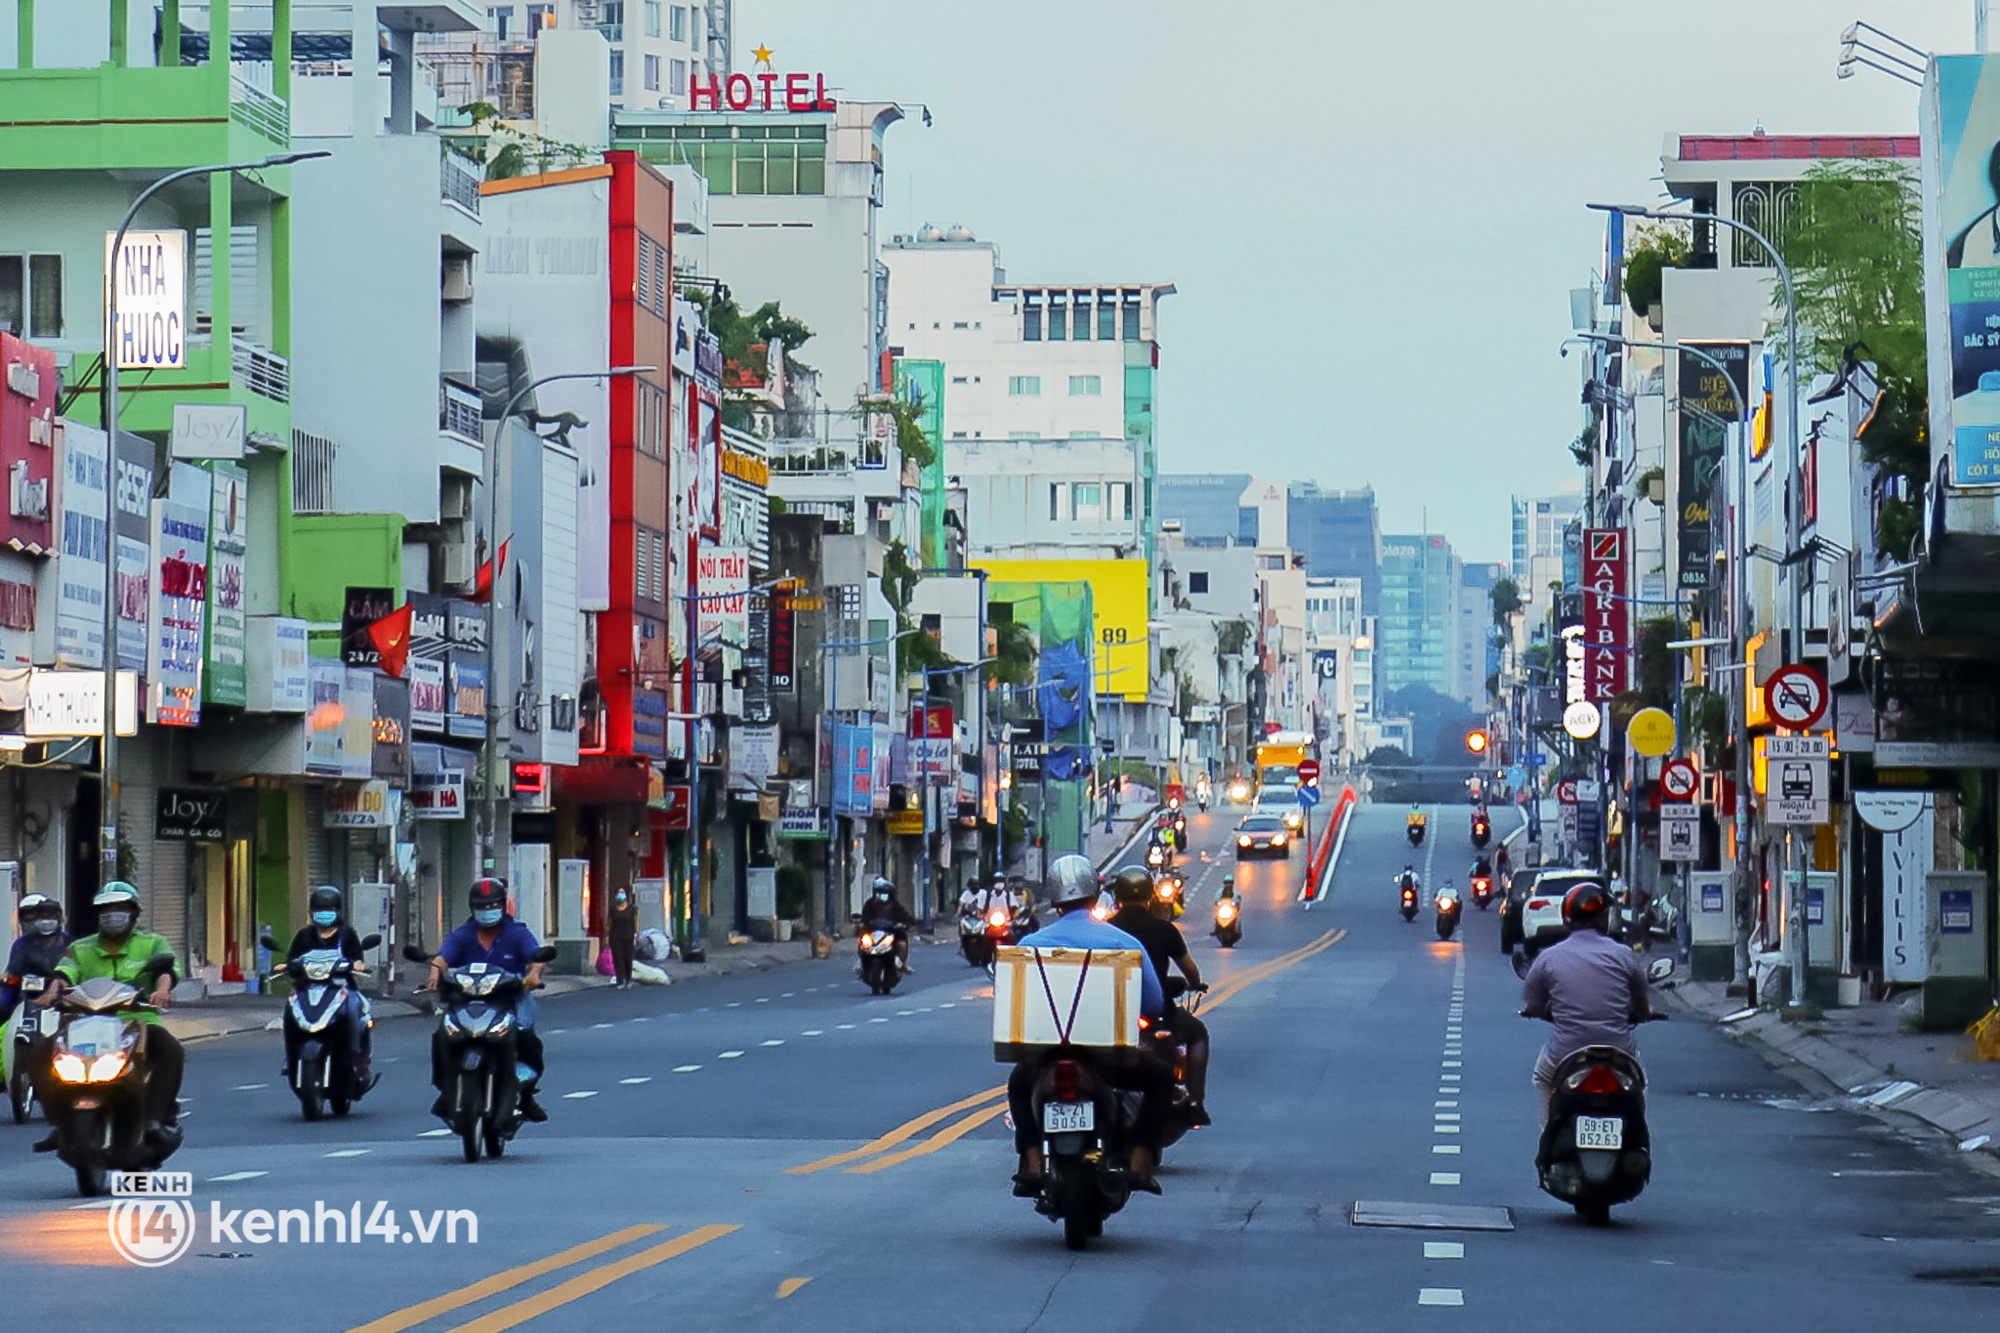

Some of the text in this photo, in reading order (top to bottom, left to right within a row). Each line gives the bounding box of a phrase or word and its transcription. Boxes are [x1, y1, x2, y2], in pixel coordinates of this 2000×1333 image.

[690, 73, 837, 111] HOTEL
[1102, 627, 1128, 644] 89
[1594, 561, 1616, 698] AGRIBANK
[348, 650, 384, 664] 24/2
[1052, 1116, 1086, 1130] 9056
